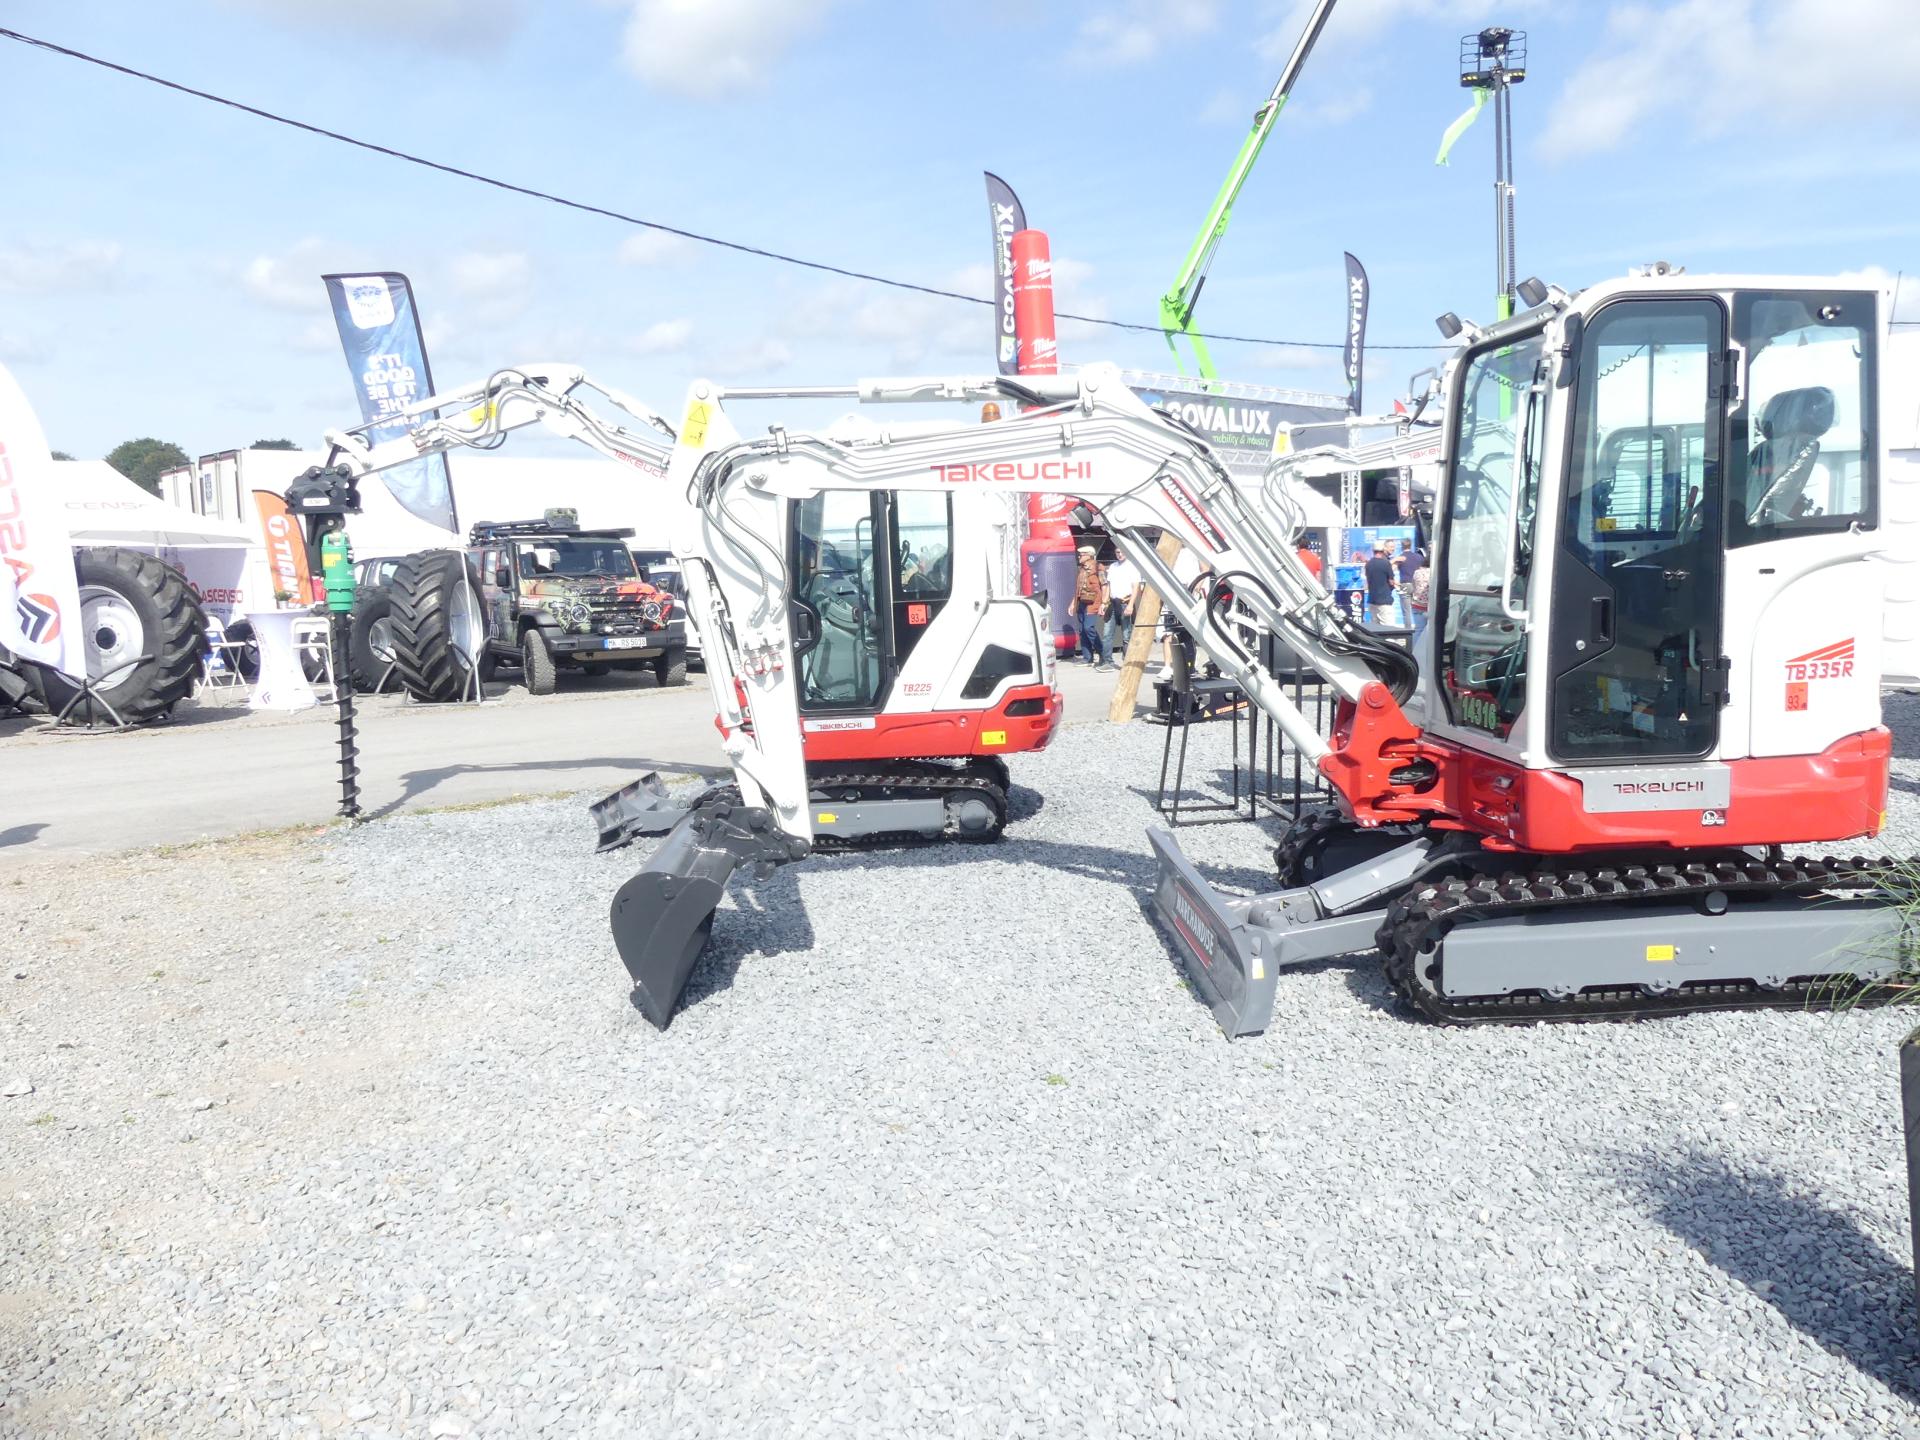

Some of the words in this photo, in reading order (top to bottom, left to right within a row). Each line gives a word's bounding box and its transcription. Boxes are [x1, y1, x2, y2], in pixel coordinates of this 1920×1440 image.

[1166, 401, 1272, 435] COVALUX
[201, 588, 244, 603] ASCENSO
[1784, 660, 1854, 681] TB335R
[903, 683, 933, 693] TB225
[1787, 694, 1800, 710] 93
[1462, 695, 1497, 730] 14316
